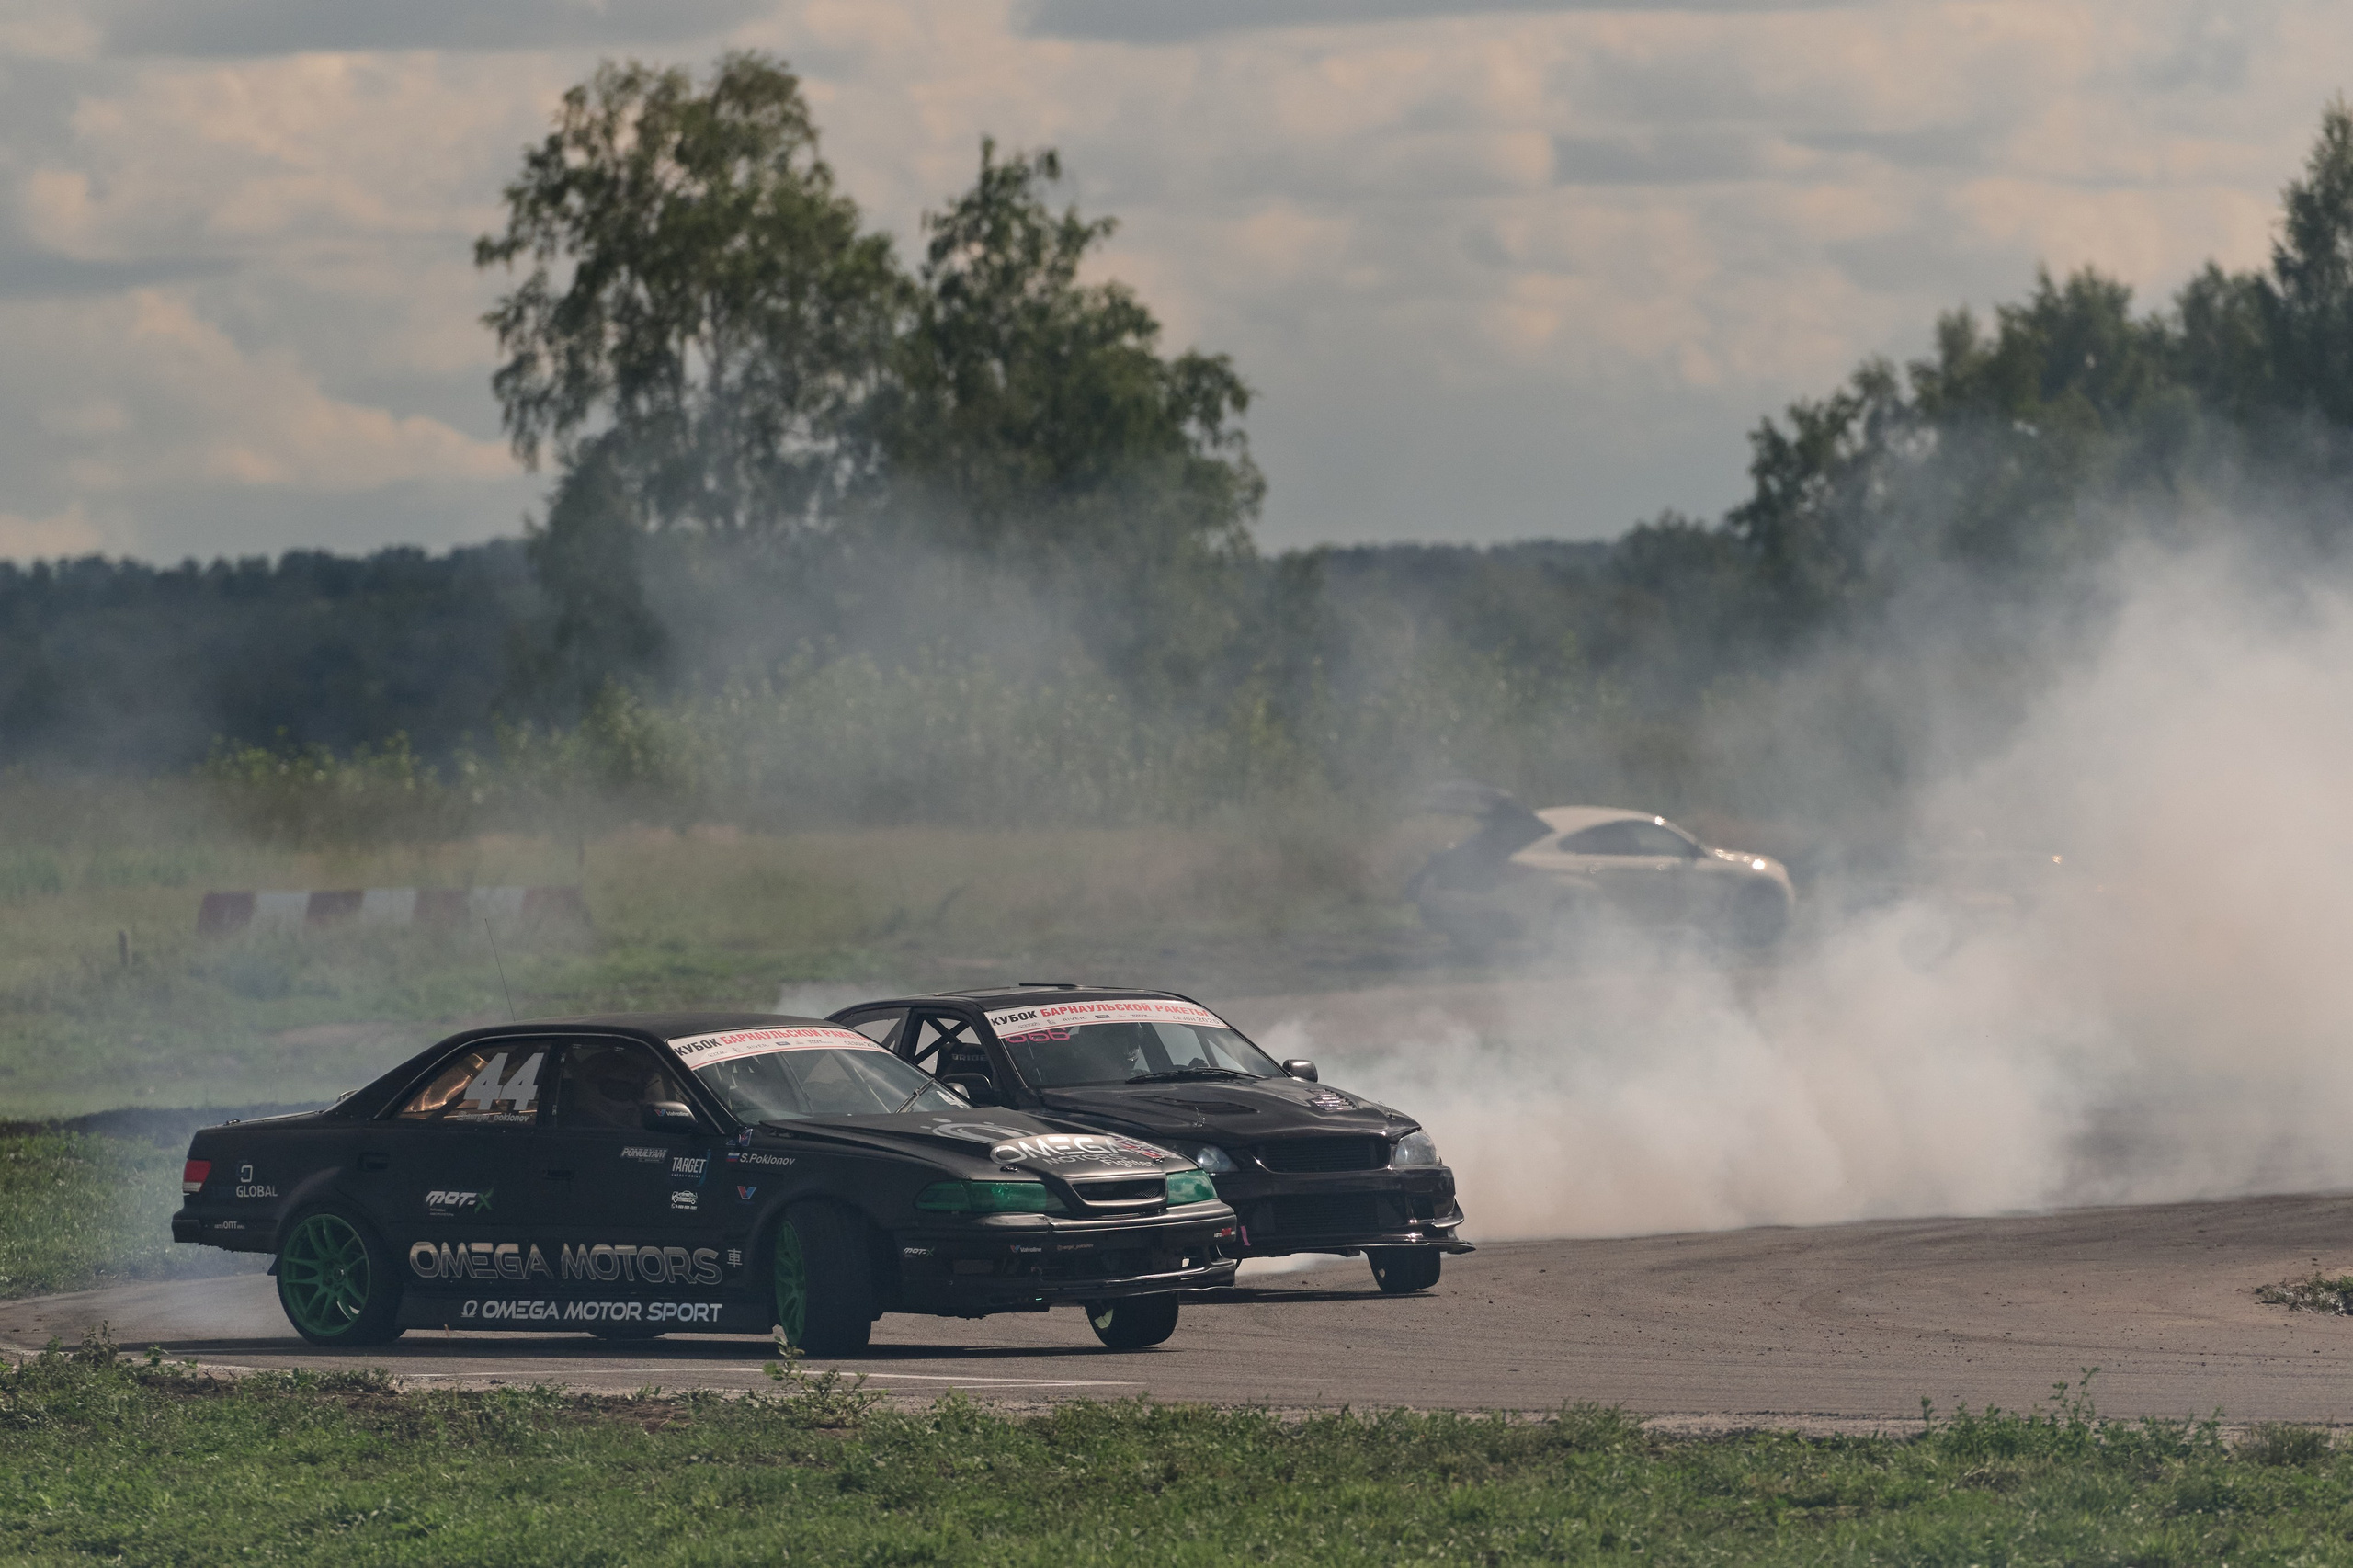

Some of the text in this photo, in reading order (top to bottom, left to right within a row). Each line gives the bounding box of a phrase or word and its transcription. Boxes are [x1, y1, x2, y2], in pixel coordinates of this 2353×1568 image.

[991, 1010, 1038, 1026] КУБОК
[1040, 1003, 1152, 1017] БАРНАУЛЬСКОЙ
[1154, 1005, 1209, 1017] РАКЕТЫ
[674, 1038, 722, 1057] КУБОК
[720, 1028, 822, 1045] БАРНАУЛЬСКОЙ
[463, 1052, 544, 1110] 44
[740, 1153, 796, 1166] S.Poklonov
[990, 1136, 1138, 1165] OMEGA
[672, 1157, 707, 1174] TARGET
[1100, 1158, 1155, 1168] Fighter
[236, 1186, 278, 1197] GLOBAL
[409, 1241, 723, 1285] OMEGA MOTORS
[727, 1248, 743, 1268] 車
[482, 1300, 560, 1320] OMEGA
[563, 1301, 642, 1321] MOTOR
[646, 1302, 723, 1323] SPORT
